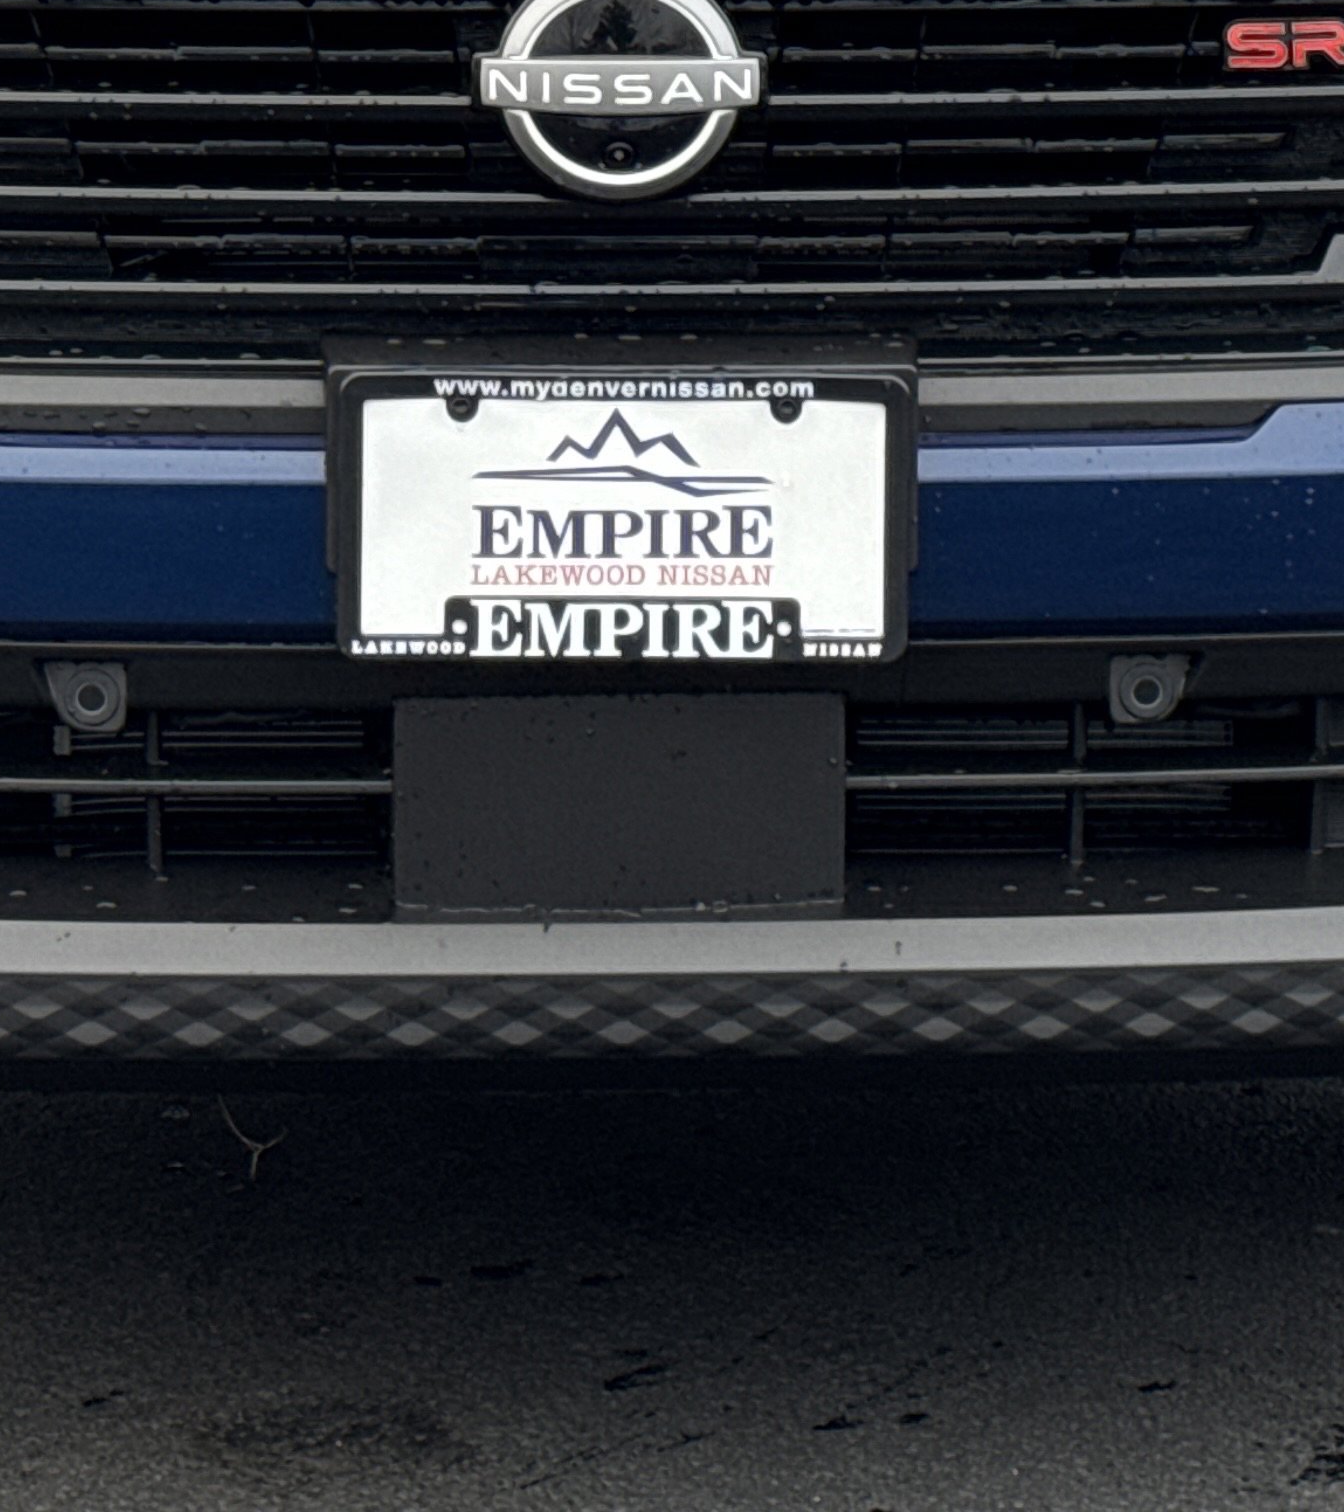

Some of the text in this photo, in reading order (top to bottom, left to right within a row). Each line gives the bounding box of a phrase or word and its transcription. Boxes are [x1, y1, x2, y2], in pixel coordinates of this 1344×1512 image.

[487, 69, 753, 105] NISSAN
[433, 378, 815, 399] www.mydenvernissan.com
[472, 505, 774, 558] EMPIRE
[471, 564, 775, 586] LAKEWOOD NISSAN
[469, 599, 774, 658] EMPIRE
[351, 639, 466, 656] LAKEWOOD
